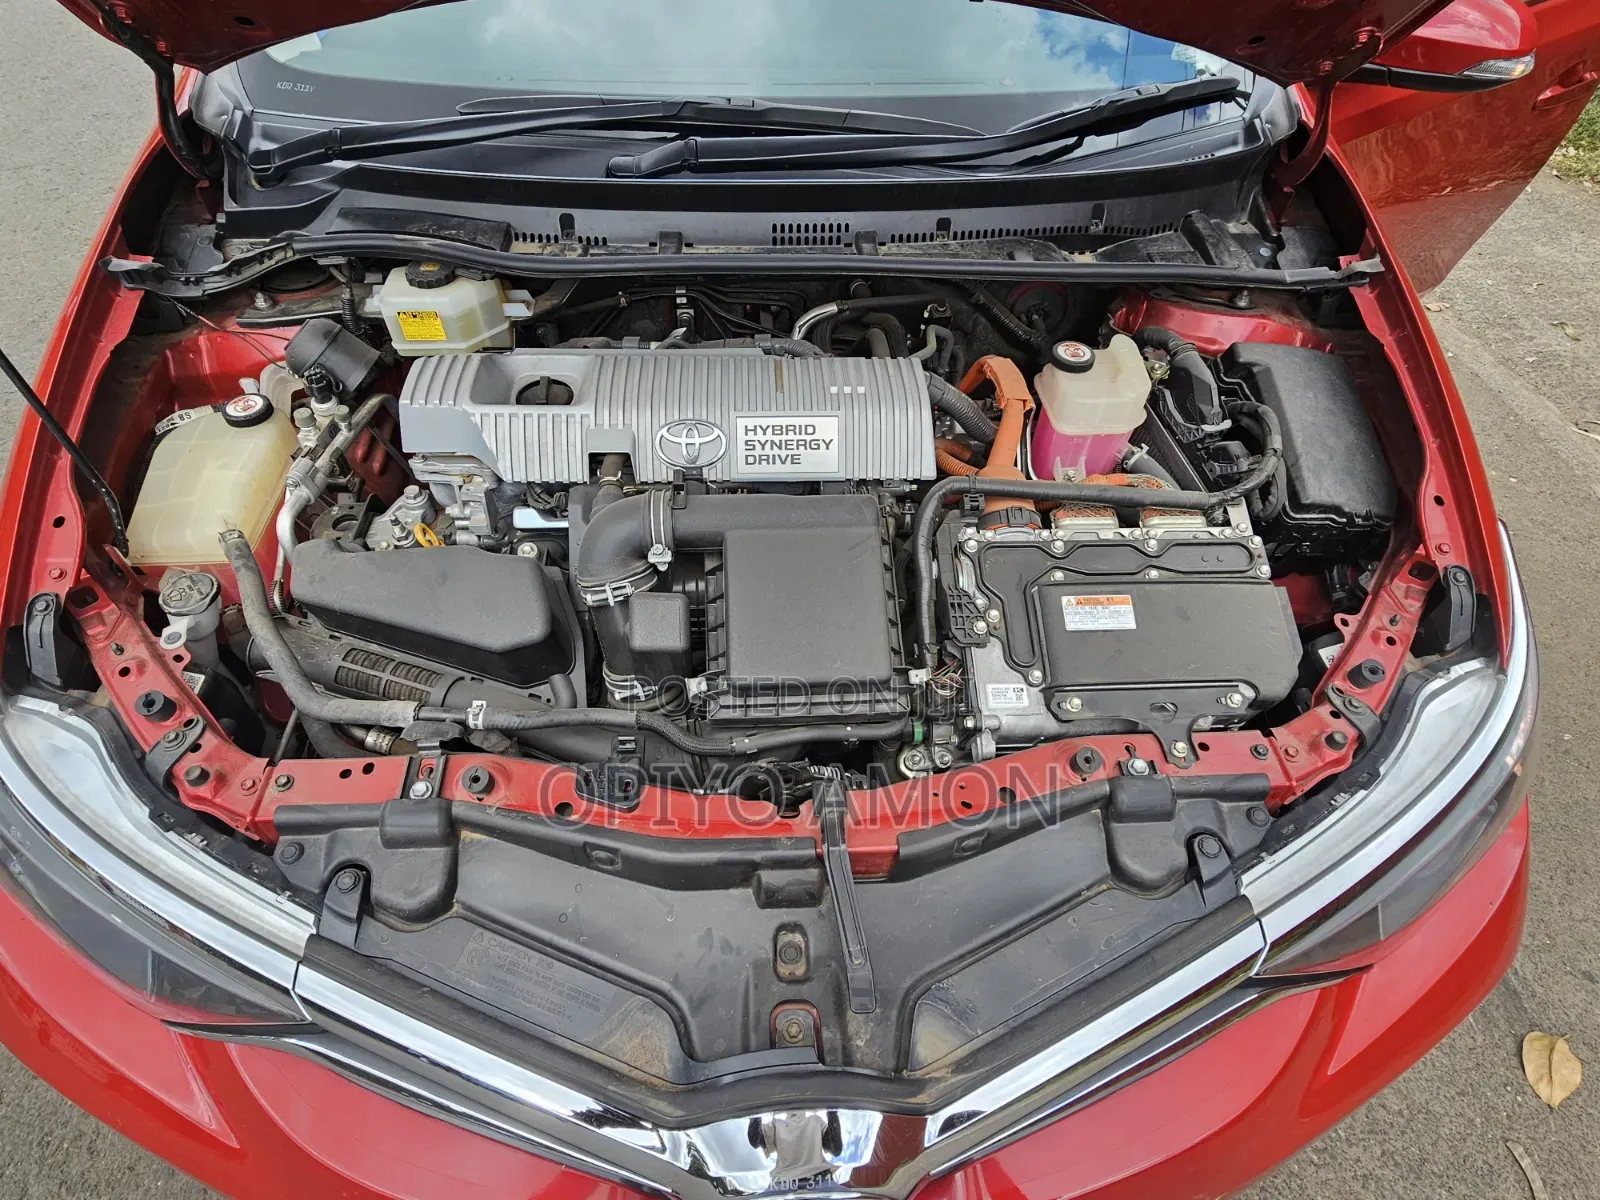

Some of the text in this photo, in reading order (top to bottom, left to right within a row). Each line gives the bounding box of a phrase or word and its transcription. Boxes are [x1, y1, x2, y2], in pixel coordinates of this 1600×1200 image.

[744, 424, 816, 436] HYBRID
[744, 438, 834, 451] SYNERGY
[744, 453, 802, 465] DRIVE
